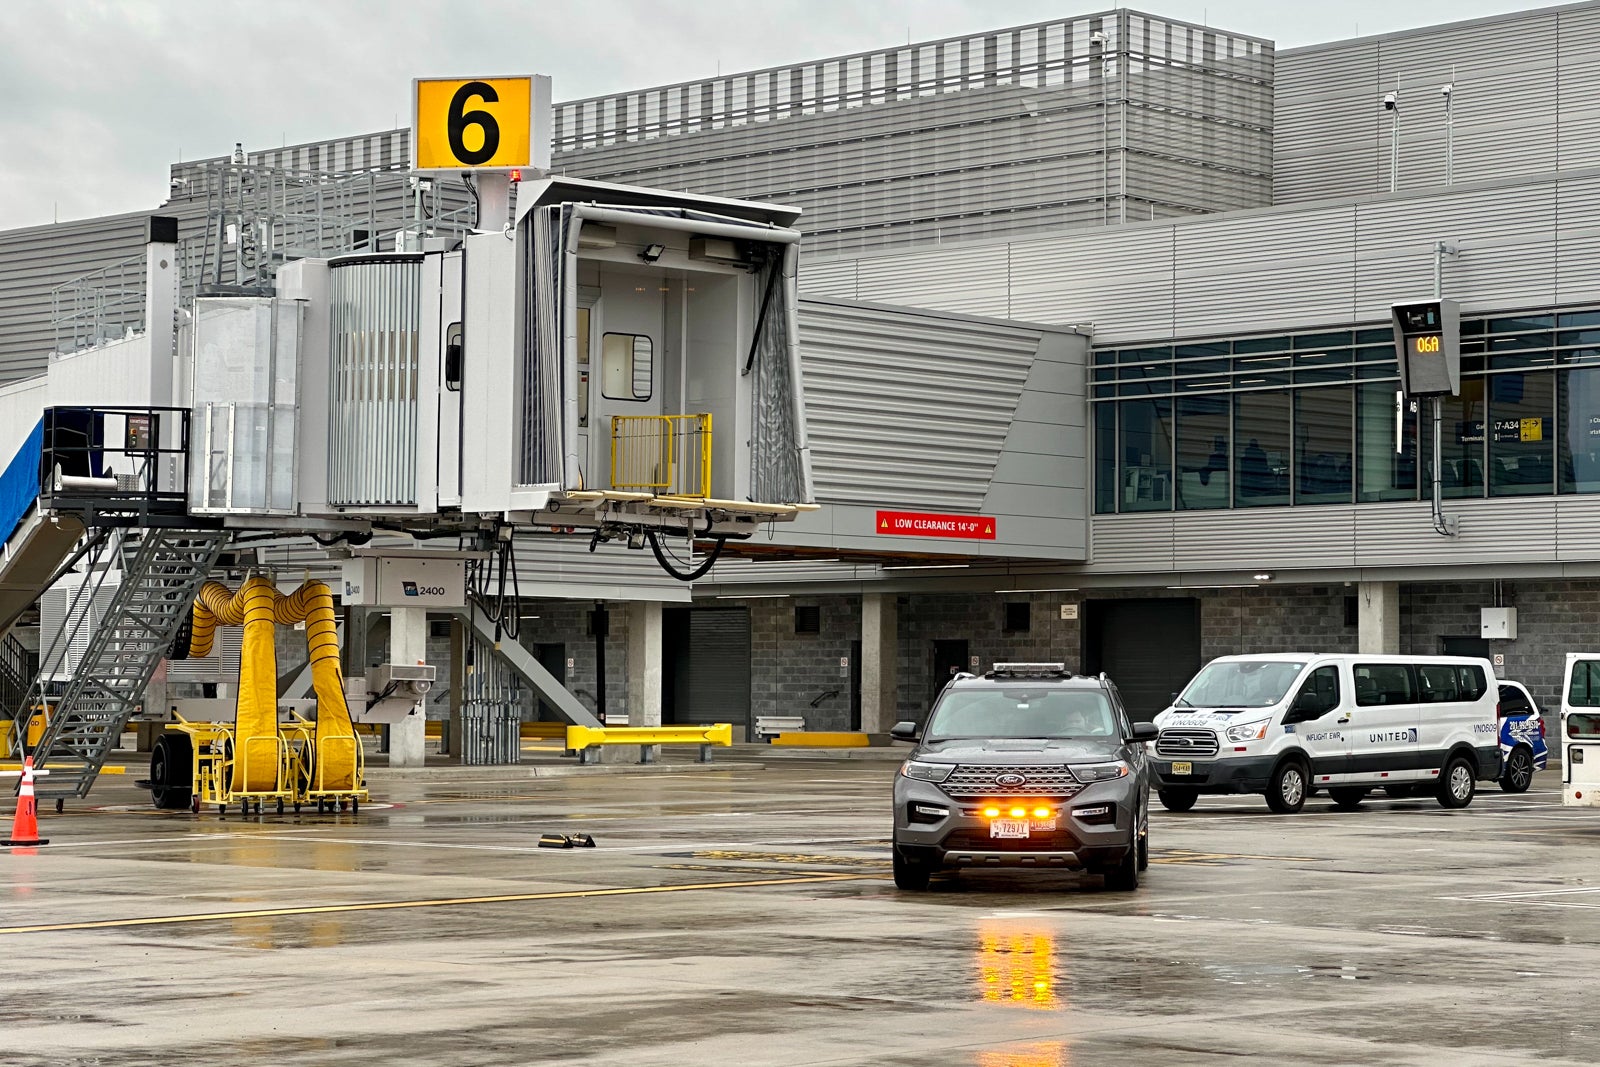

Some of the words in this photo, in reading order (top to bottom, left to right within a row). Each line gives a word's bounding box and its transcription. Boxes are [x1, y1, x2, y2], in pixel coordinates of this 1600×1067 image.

[448, 82, 500, 165] 6
[1417, 336, 1439, 352] 06A
[895, 518, 913, 529] LOW
[914, 519, 956, 531] CLEARANCE
[419, 586, 445, 596] 2400
[1306, 732, 1328, 741] INFLIGHT
[1329, 731, 1341, 740] EWR
[1369, 731, 1408, 743] UNITED
